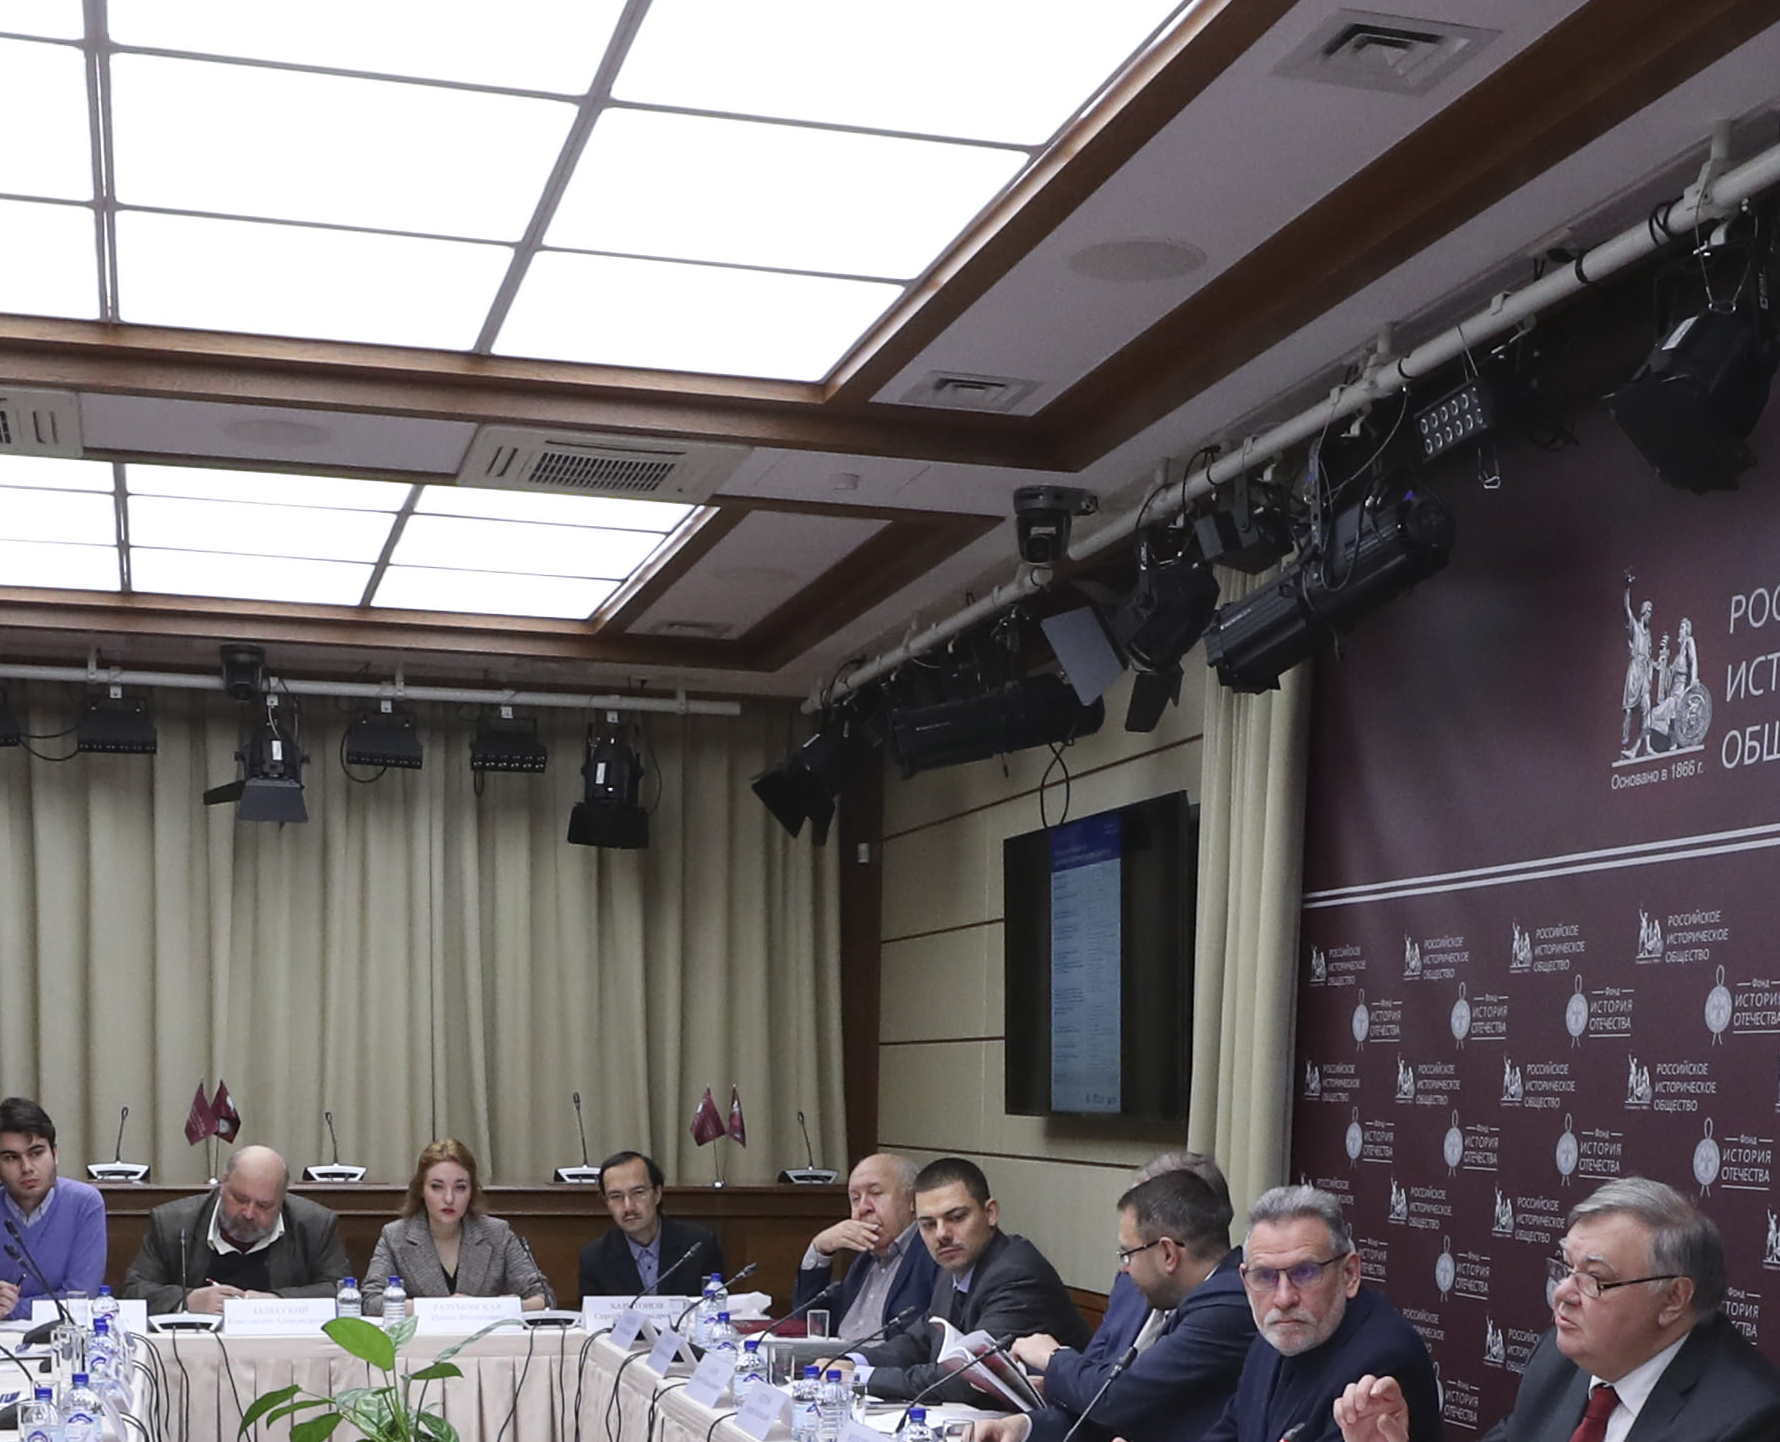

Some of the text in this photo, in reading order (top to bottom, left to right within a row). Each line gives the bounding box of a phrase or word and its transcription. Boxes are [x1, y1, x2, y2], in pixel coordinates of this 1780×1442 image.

[1611, 770, 1659, 789] Основано
[1662, 770, 1667, 780] в
[1671, 760, 1695, 779] 1866
